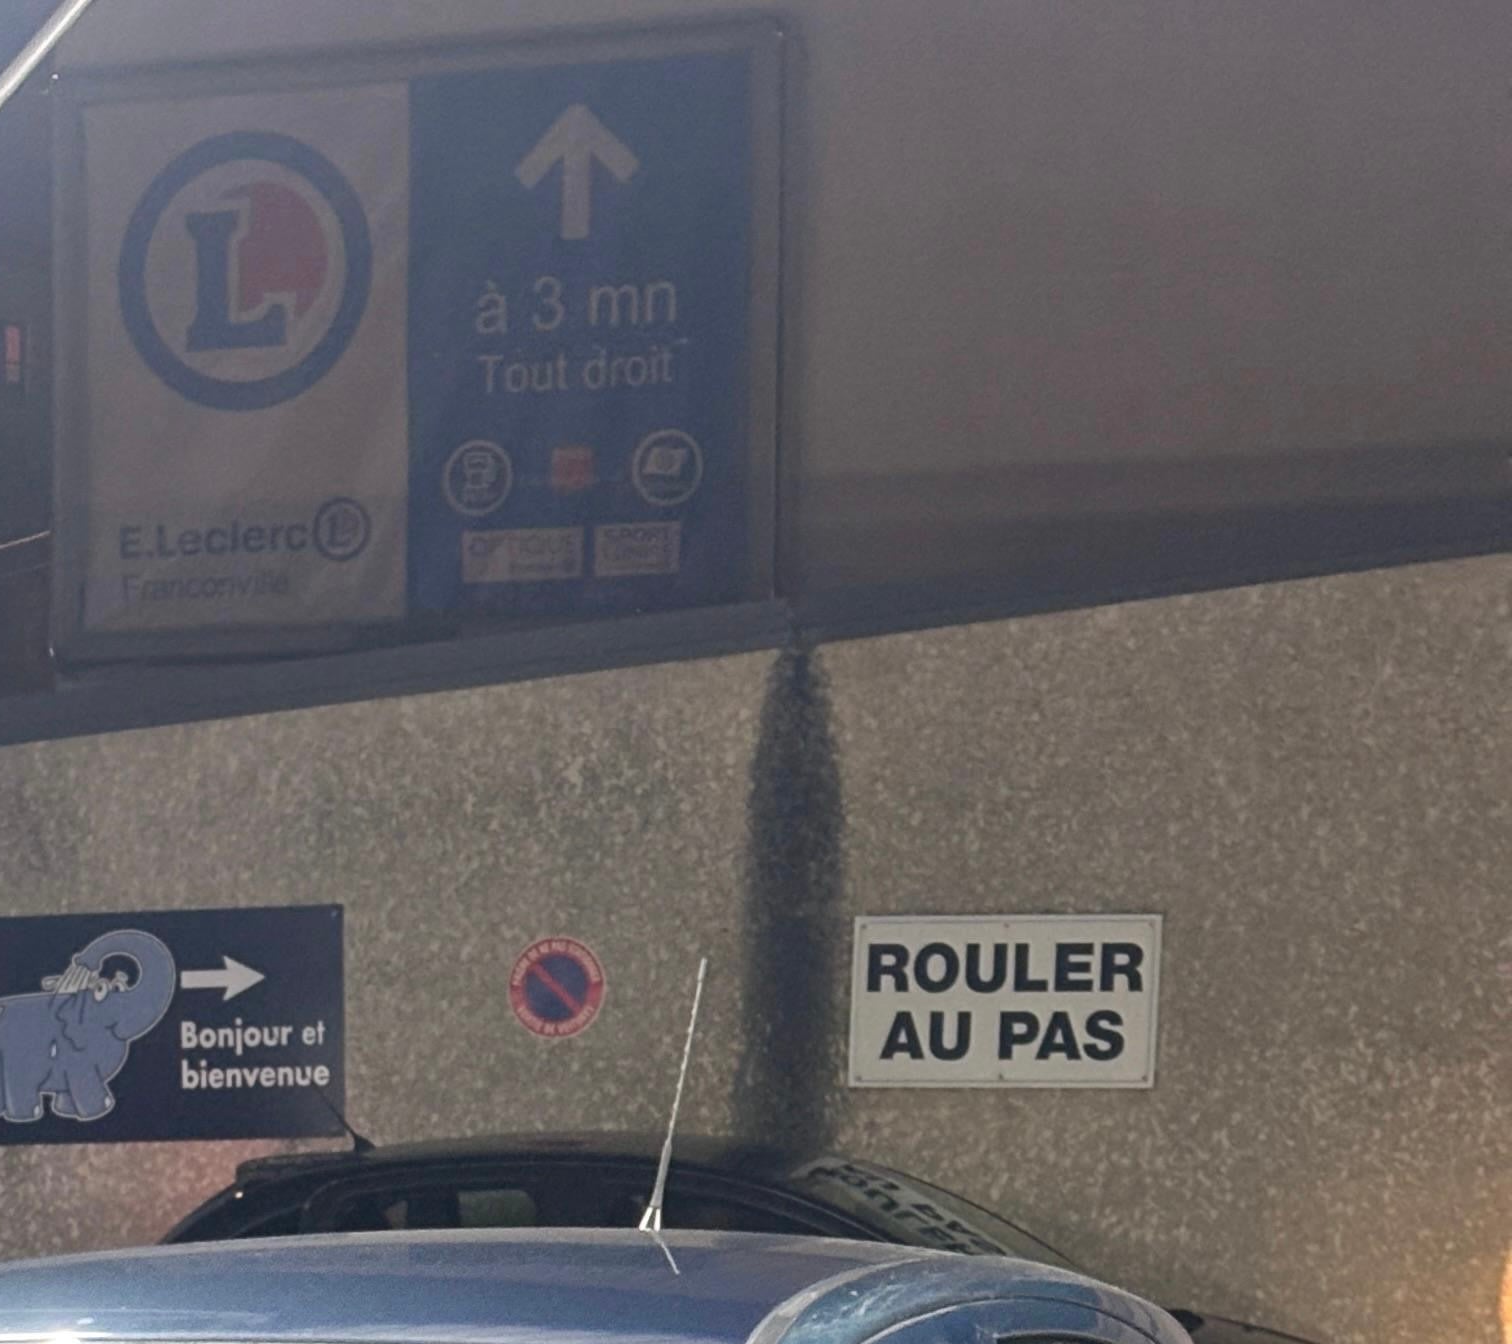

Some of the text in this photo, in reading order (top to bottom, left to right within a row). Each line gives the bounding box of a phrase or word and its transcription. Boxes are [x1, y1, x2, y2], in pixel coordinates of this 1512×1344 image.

[475, 274, 677, 335] à 3 mn
[476, 345, 673, 394] Tout droit
[866, 942, 1144, 994] ROULER
[180, 1018, 325, 1056] Bonjour et
[880, 1010, 1126, 1061] AU PAS
[181, 1059, 330, 1090] bienvenue
